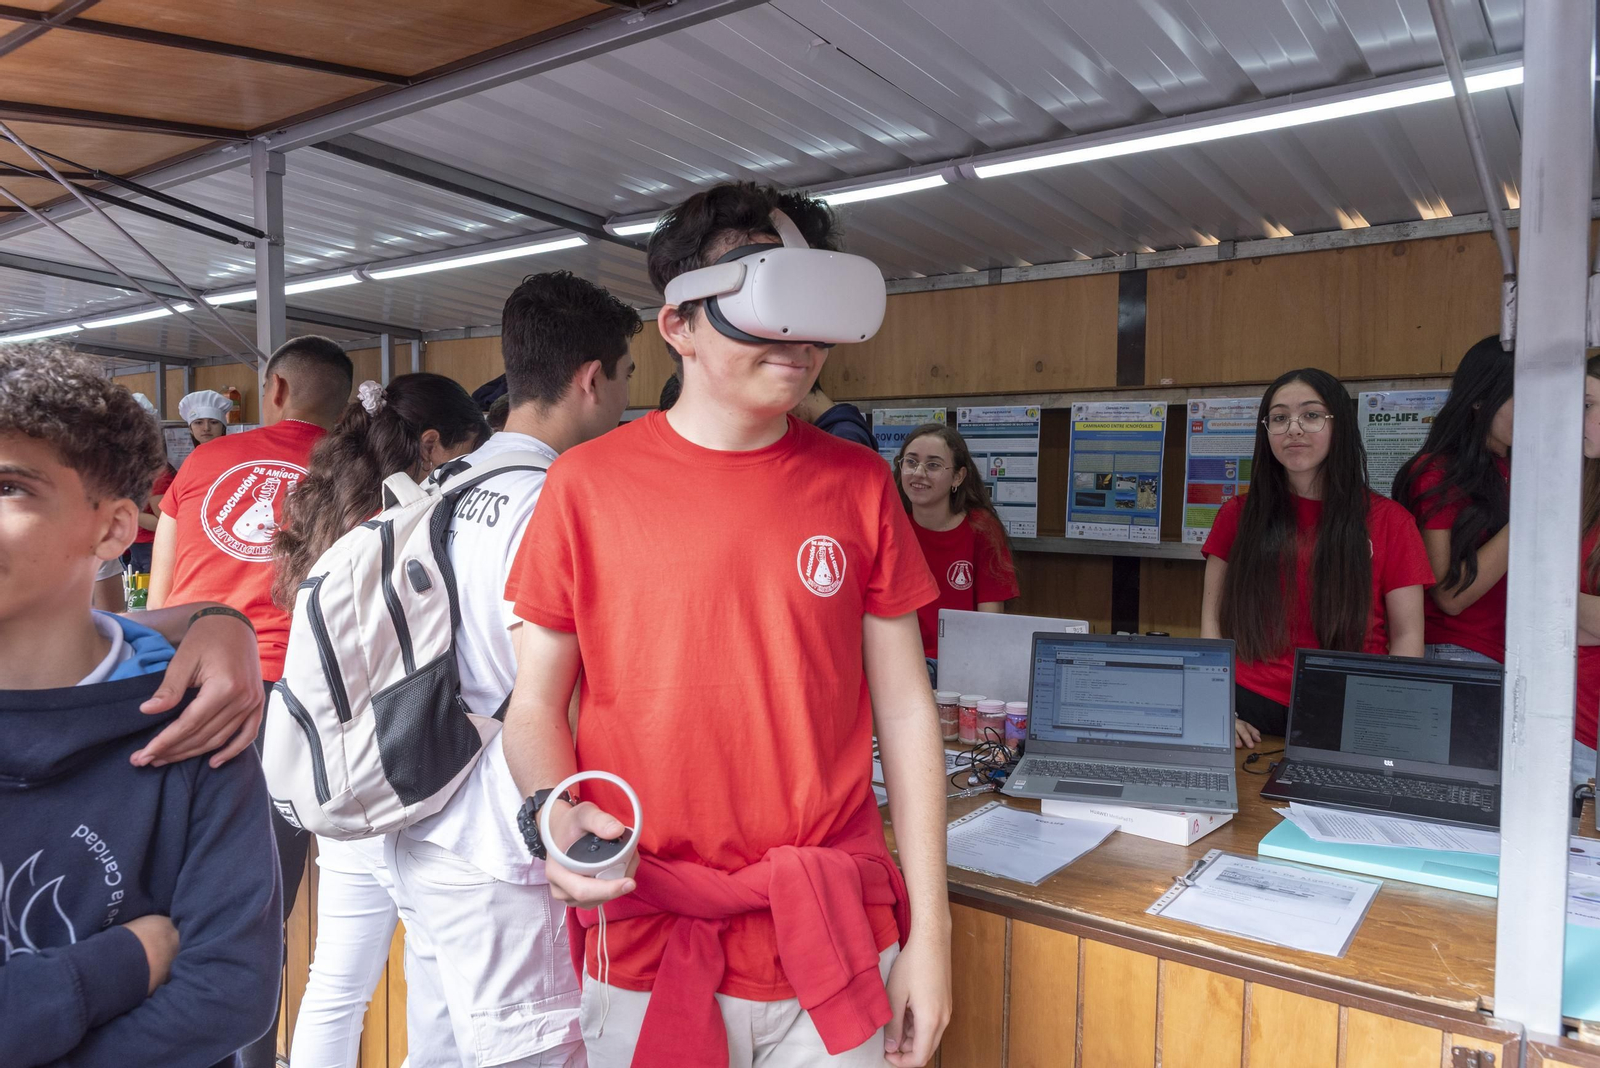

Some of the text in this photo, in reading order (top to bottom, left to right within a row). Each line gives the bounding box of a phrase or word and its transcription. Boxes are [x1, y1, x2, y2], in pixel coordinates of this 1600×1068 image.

[1368, 412, 1418, 422] ECO-LIFE
[876, 433, 892, 441] ROV
[216, 473, 258, 525] ASOCIACIÓN
[253, 466, 266, 475] DE
[1090, 809, 1108, 817] HUAWEI
[70, 824, 122, 886] Caridad
[107, 890, 124, 906] la
